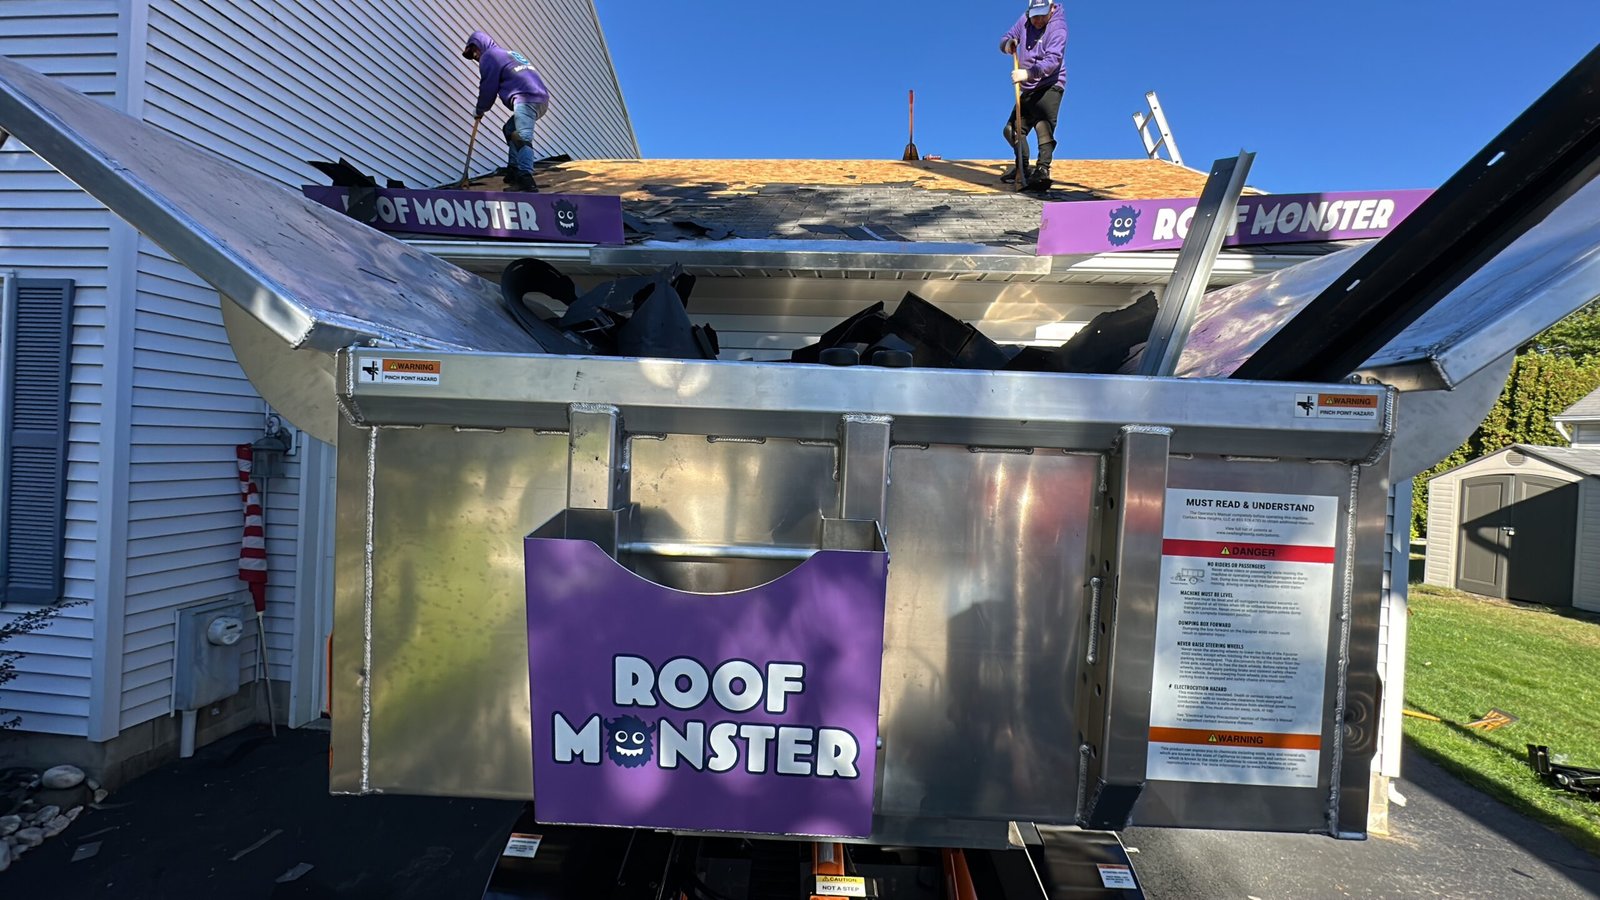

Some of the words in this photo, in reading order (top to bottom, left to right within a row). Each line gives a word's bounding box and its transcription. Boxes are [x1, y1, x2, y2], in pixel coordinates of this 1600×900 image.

[413, 197, 540, 231] MONSTER
[1153, 205, 1250, 241] ROF
[1250, 199, 1396, 235] MONSTER
[398, 362, 434, 371] WARNING
[1334, 397, 1371, 405] WARNING
[1186, 498, 1213, 508] MUST
[1215, 499, 1241, 509] READ
[1243, 501, 1250, 509] &
[1252, 502, 1315, 512] UNDERSTAND
[1232, 546, 1275, 557] DANGER
[613, 654, 805, 713] ROOF
[1217, 734, 1264, 745] WARNING
